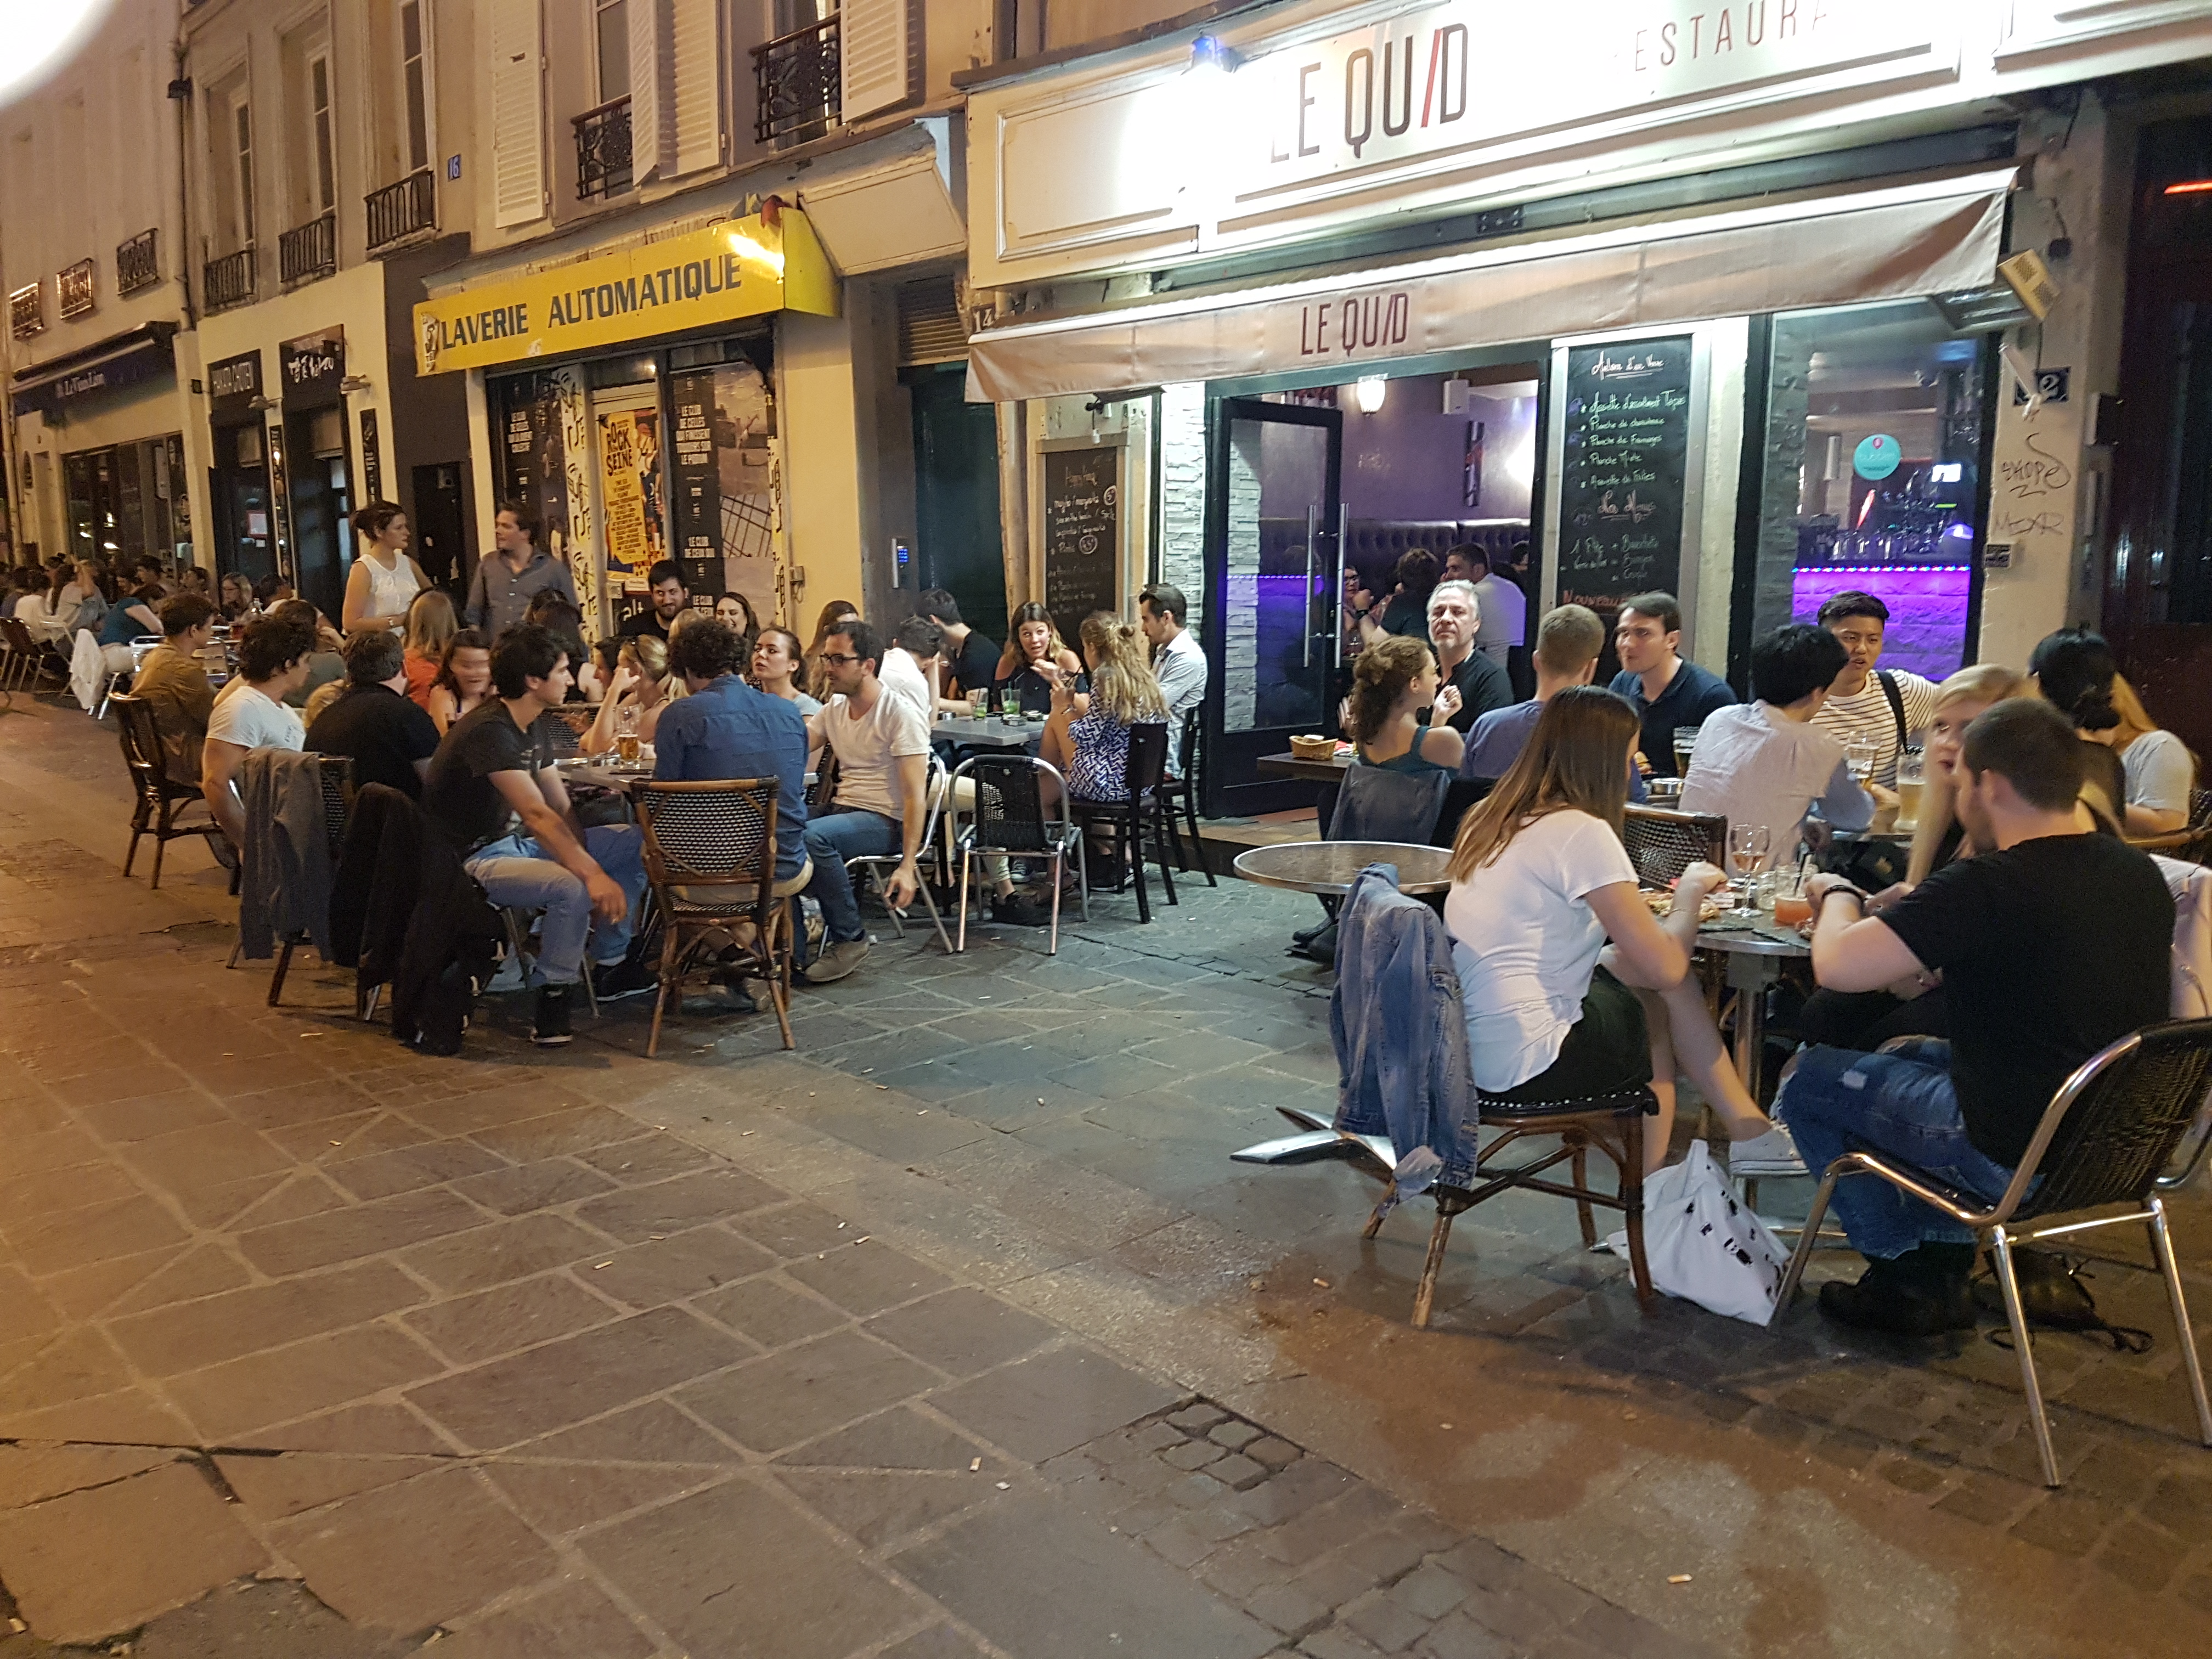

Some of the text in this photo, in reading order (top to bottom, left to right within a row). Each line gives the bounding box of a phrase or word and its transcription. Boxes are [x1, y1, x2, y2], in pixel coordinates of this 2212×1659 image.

[1271, 62, 1321, 163] LE
[450, 156, 459, 179] 16
[441, 303, 529, 349] LAVERIE
[548, 252, 741, 328] AUTOMATIQUE
[973, 308, 994, 333] 14
[1302, 303, 1331, 356] LE
[607, 422, 631, 453] ROCK
[606, 449, 633, 476] SEINE
